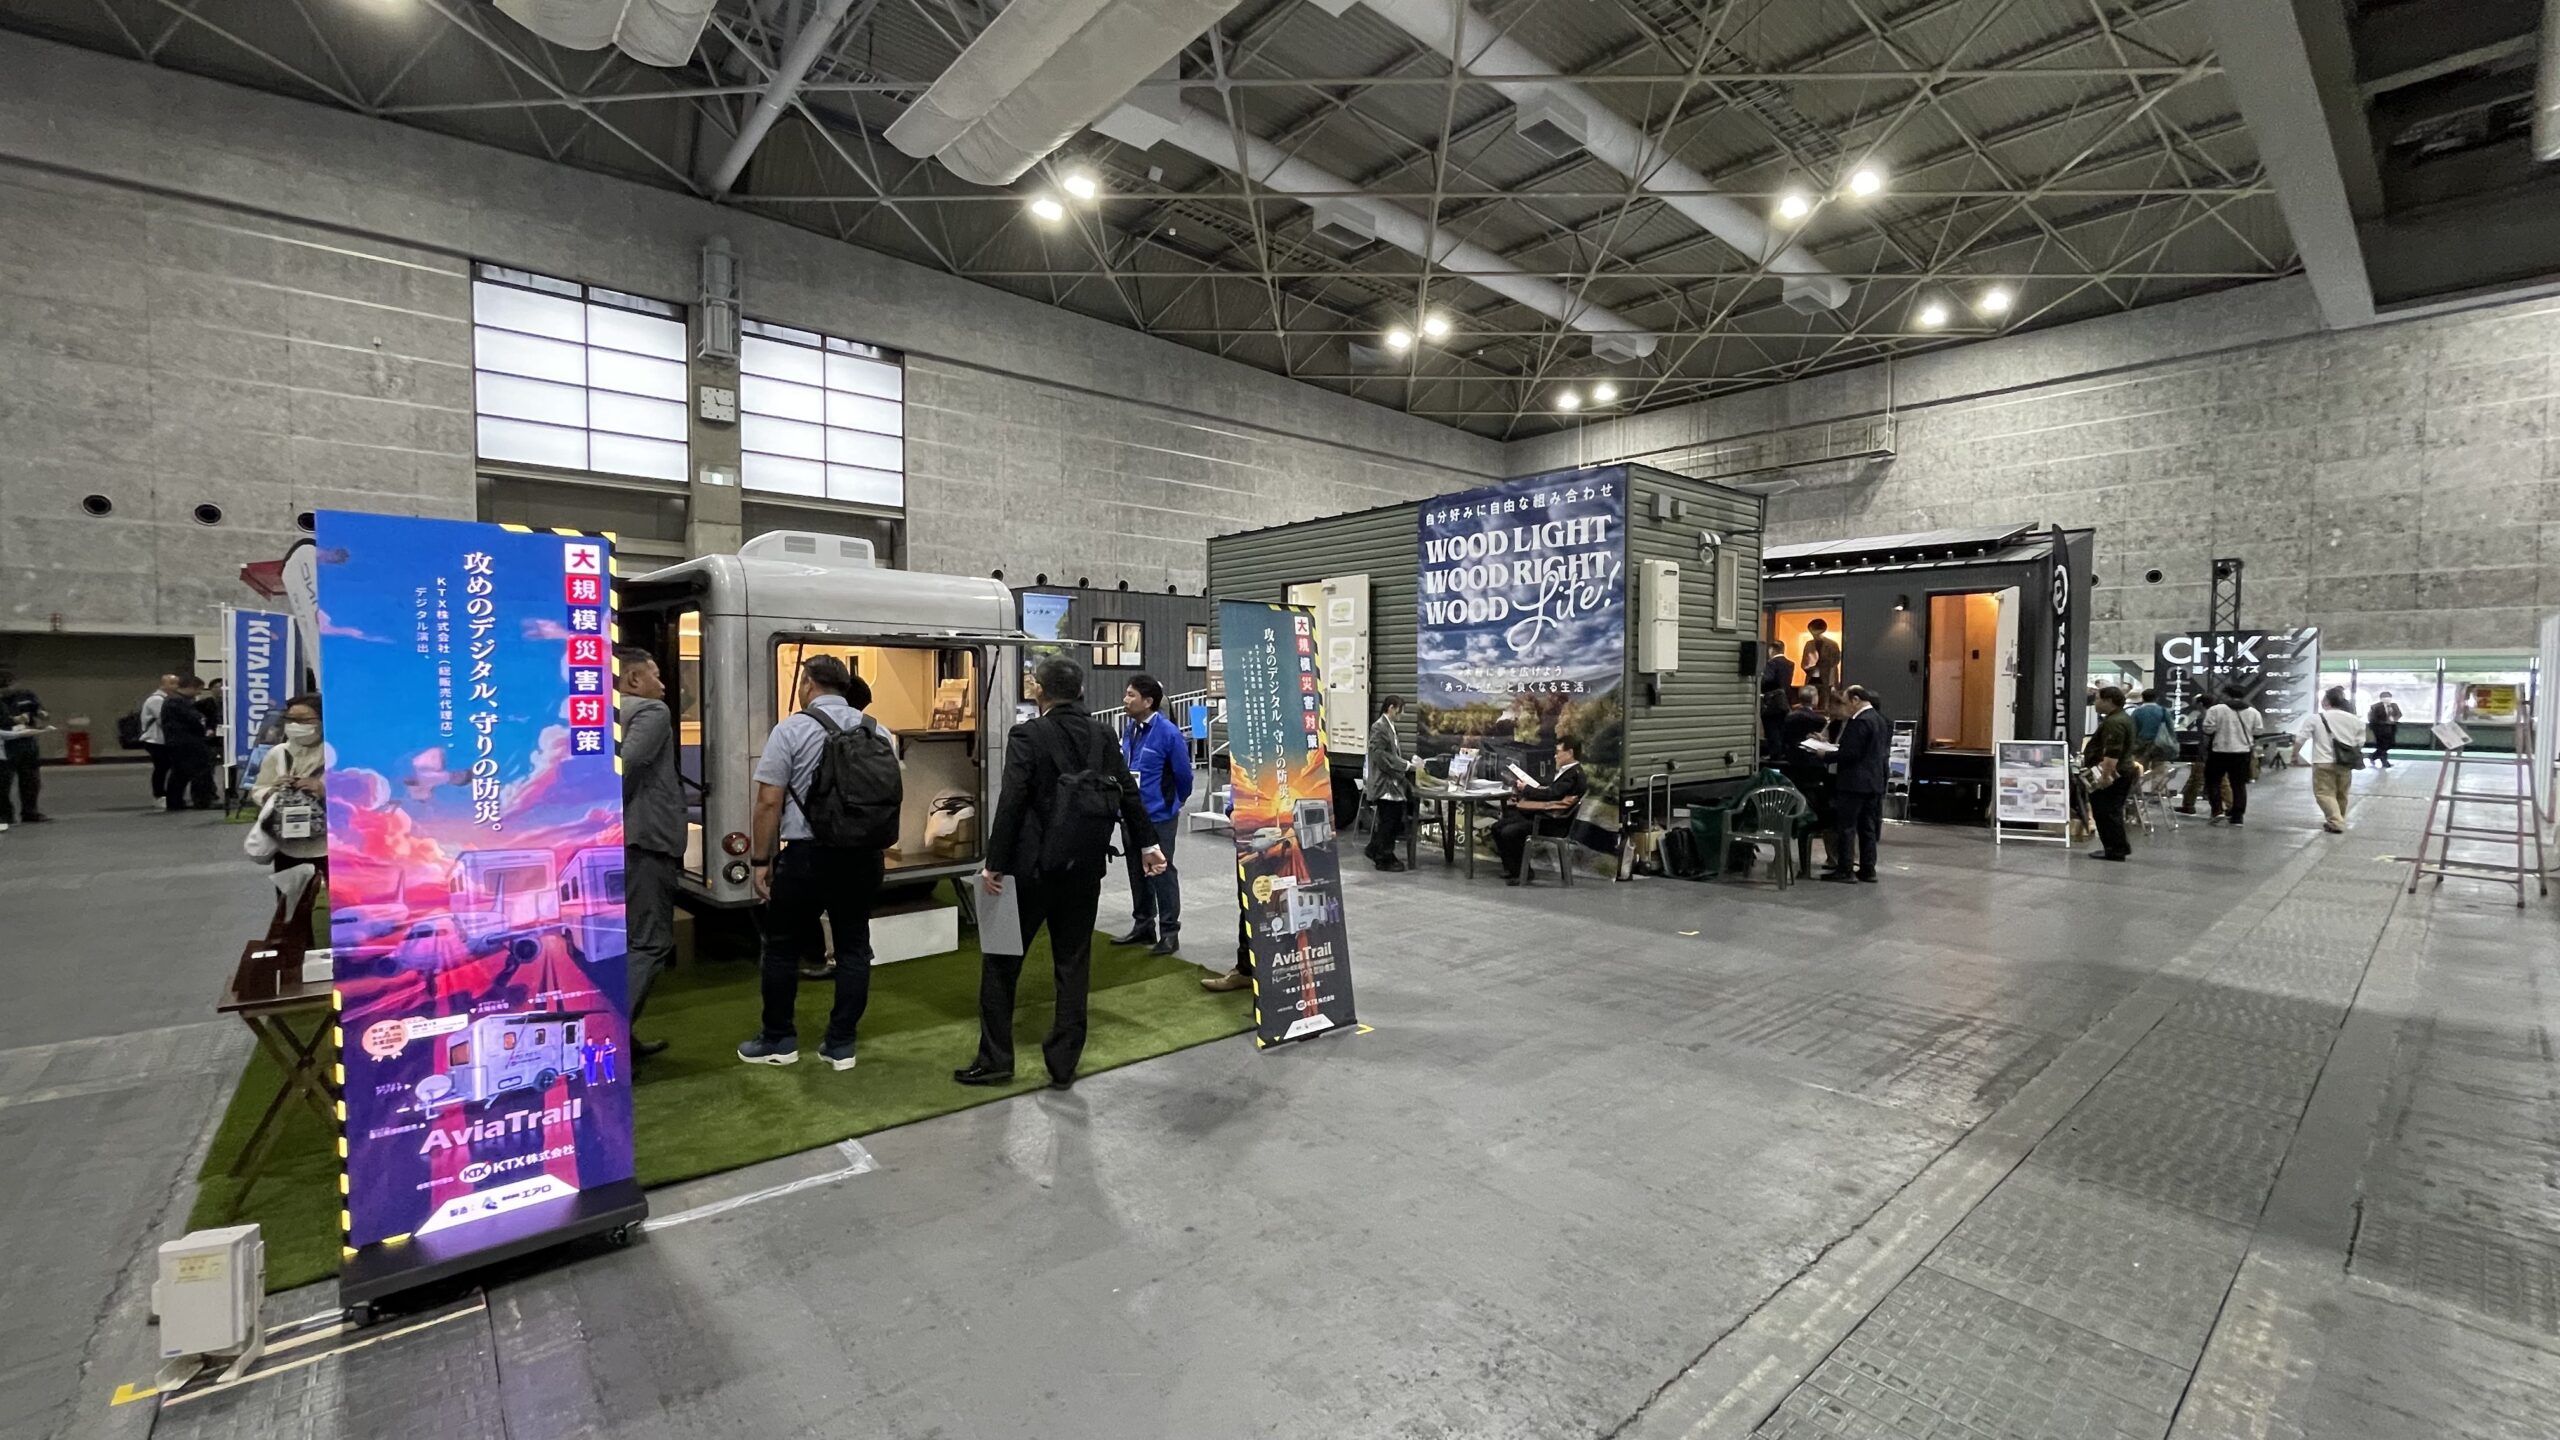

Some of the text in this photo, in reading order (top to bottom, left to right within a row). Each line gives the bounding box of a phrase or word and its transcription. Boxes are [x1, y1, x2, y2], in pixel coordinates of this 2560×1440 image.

[1425, 483, 1613, 526] 自分好みに自由な組み合わせ
[1426, 515, 1612, 564] WOOD LIGHT
[1425, 551, 1612, 594] WOOD RIGHT
[1425, 596, 1509, 624] WOOD
[570, 547, 602, 752] 大規模災害対策
[463, 552, 503, 831] 攻めのデジタル、守りの防災。
[1296, 617, 1319, 749] 大規模災害対策
[1271, 941, 1332, 968] AviaTrail
[419, 1098, 583, 1155] AviaTrail
[492, 1144, 576, 1174] KTX株式会社
